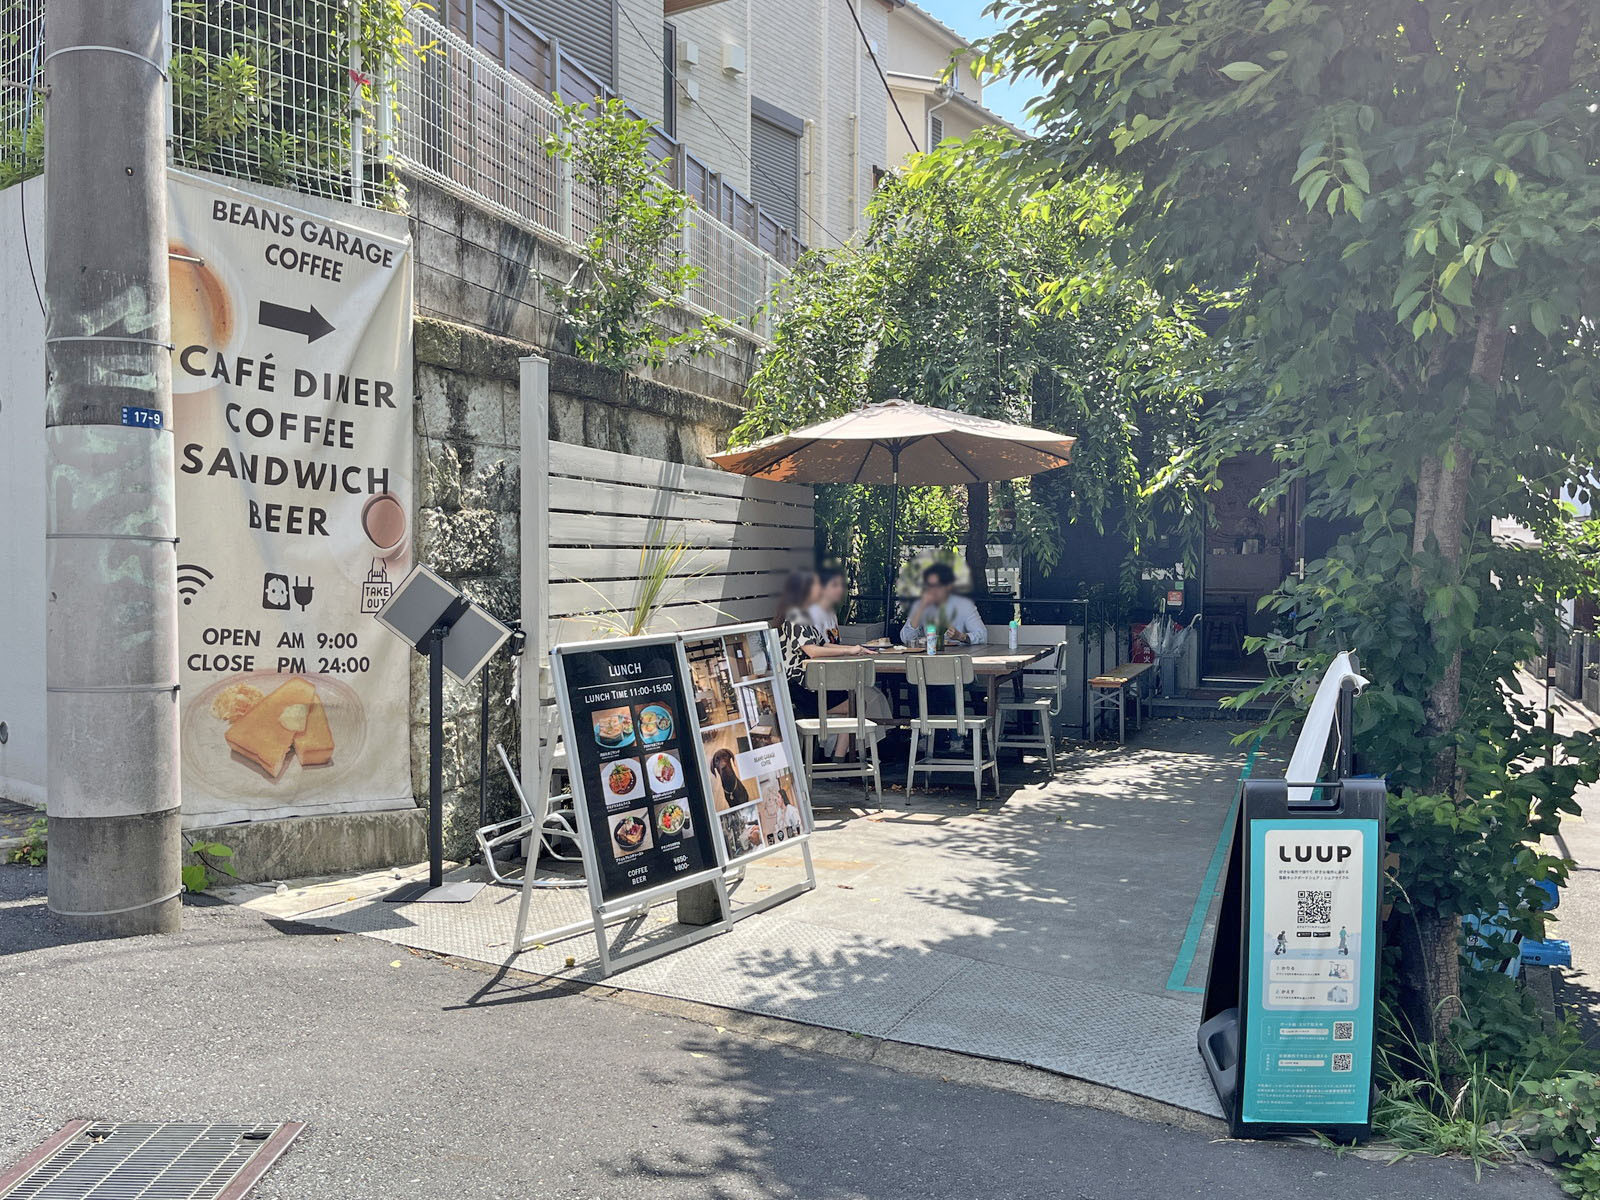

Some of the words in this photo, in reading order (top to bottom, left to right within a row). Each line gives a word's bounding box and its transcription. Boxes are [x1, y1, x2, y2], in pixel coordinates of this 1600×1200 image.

[212, 200, 294, 237] BEANS
[300, 221, 393, 268] GARAGE
[265, 244, 343, 282] COFFEE
[179, 345, 276, 393] CAFÉ
[294, 368, 397, 409] DINER
[134, 411, 160, 425] 17-9
[225, 402, 354, 449] COFFEE
[180, 443, 389, 495] SANDWICH
[249, 499, 330, 536] BEER
[365, 586, 390, 596] TAKE
[367, 598, 386, 608] OUT
[202, 628, 261, 647] OPEN
[277, 632, 305, 649] AM
[316, 632, 358, 649] 9:00
[187, 653, 254, 672] CLOSE
[277, 657, 306, 673] PM
[318, 657, 370, 673] 24:00
[608, 662, 642, 677] LUNCH
[585, 692, 611, 703] LUNCH
[629, 683, 672, 697] 11:00-15:00
[1279, 845, 1352, 863] LUUP
[627, 865, 648, 877] COFFEE
[631, 875, 647, 885] BEER
